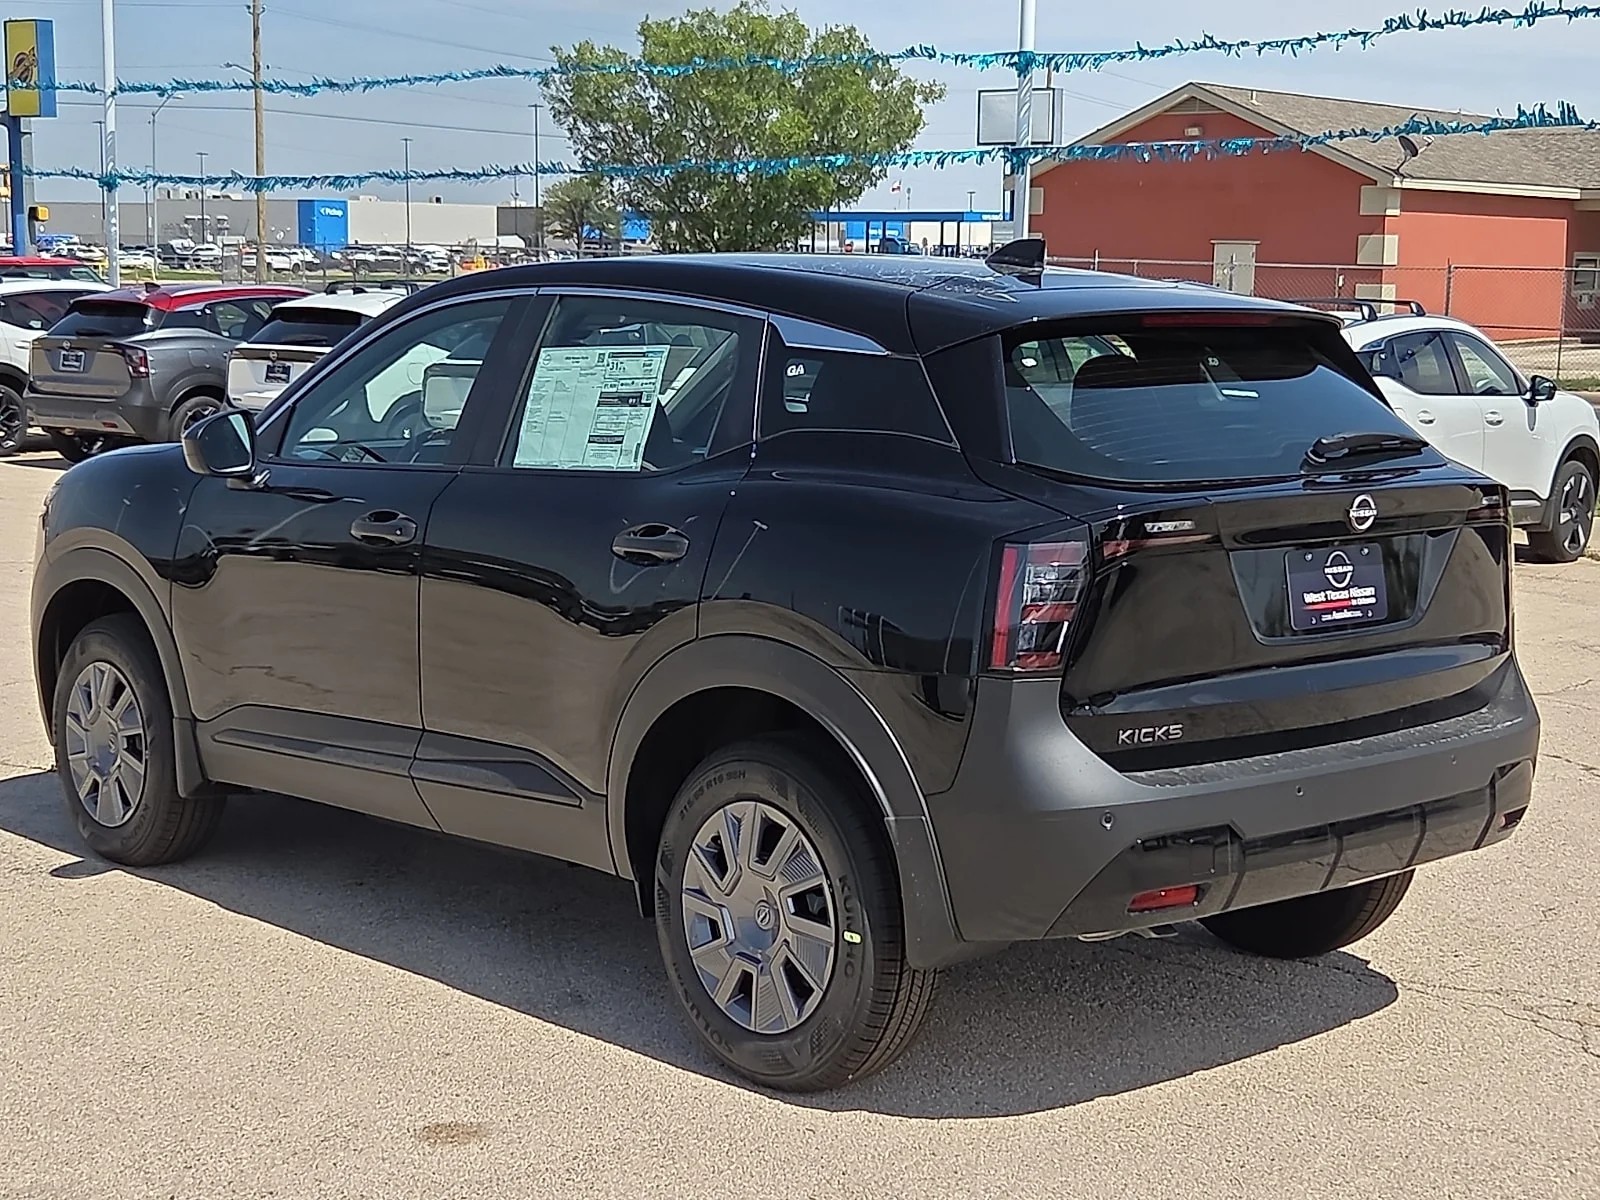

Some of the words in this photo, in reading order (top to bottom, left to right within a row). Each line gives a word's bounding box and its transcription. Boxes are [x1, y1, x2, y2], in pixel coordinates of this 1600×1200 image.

[325, 206, 344, 217] Pickup
[1349, 508, 1377, 518] NISSAN
[1324, 565, 1354, 574] NISSAN
[1303, 591, 1326, 604] West
[1326, 589, 1349, 601] Texas
[1349, 586, 1375, 598] Nissan
[1117, 723, 1184, 745] KICKS
